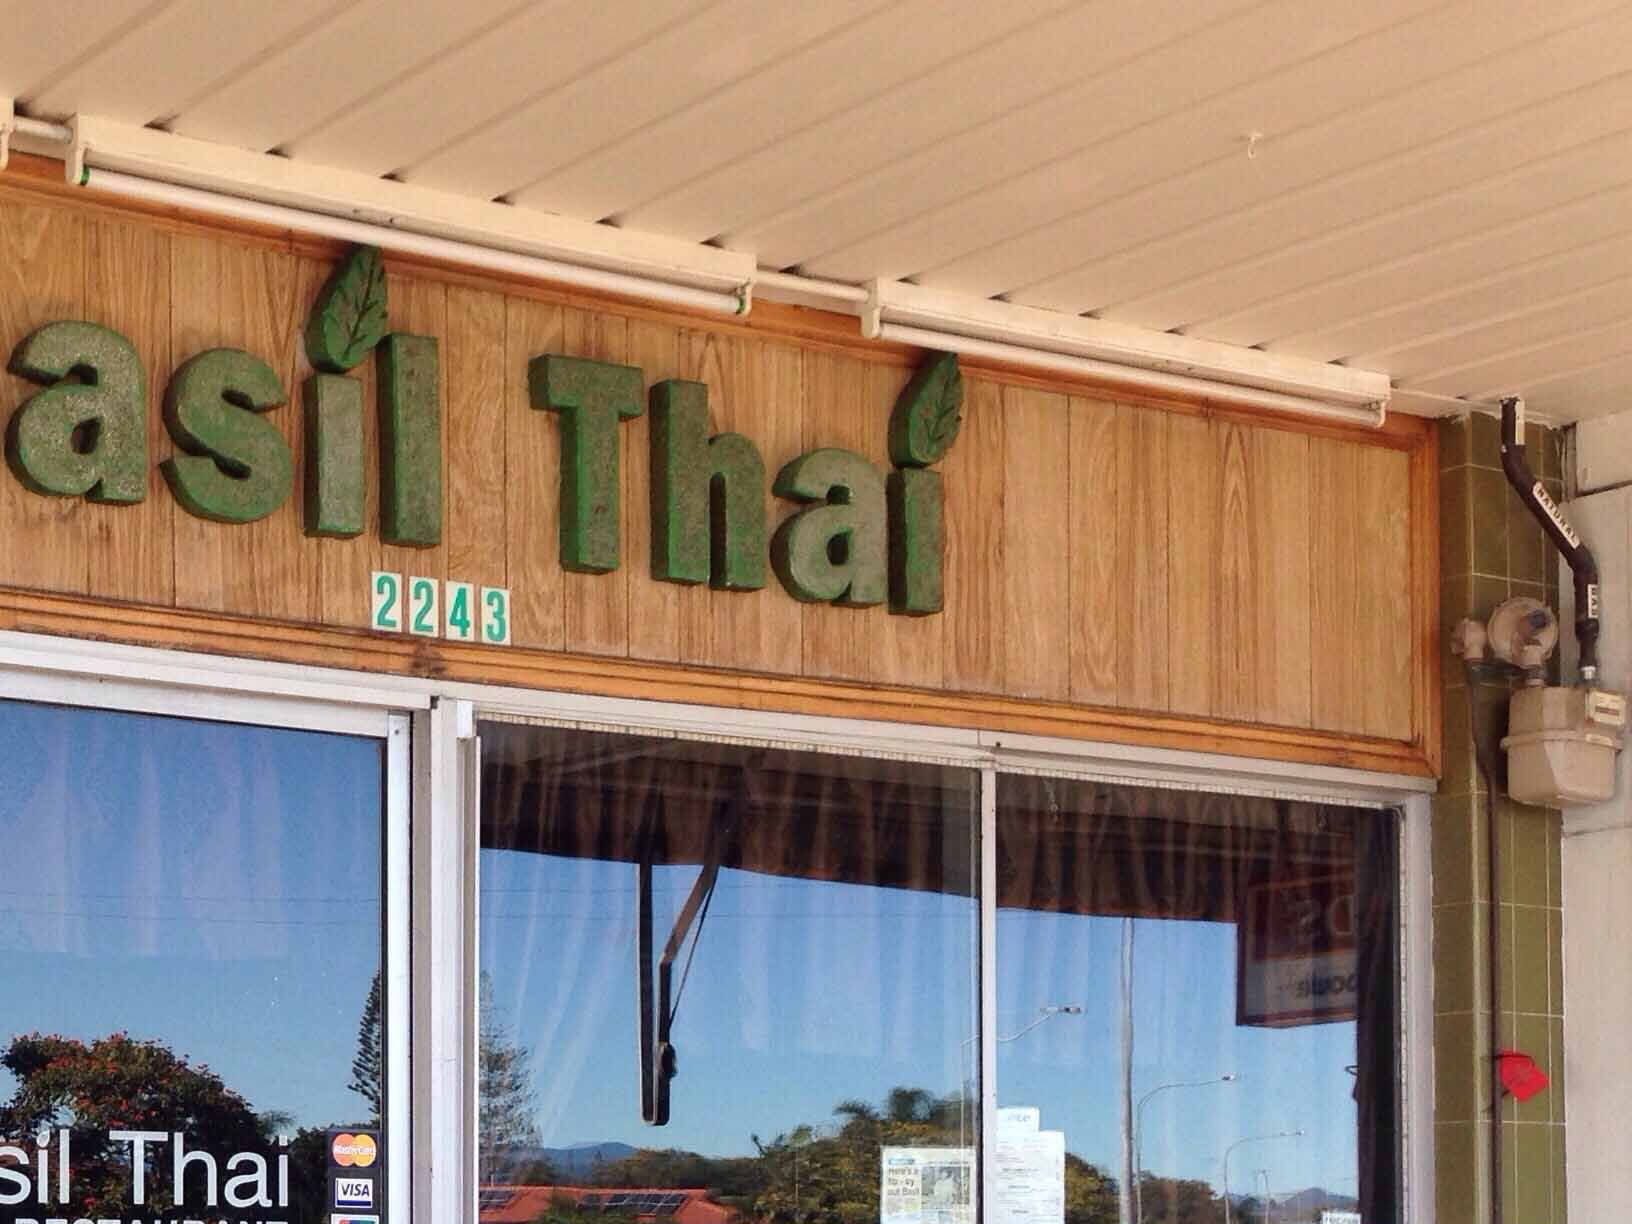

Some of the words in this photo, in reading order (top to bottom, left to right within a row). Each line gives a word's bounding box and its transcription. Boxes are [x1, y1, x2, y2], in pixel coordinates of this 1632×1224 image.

[528, 352, 963, 617] Thai
[376, 574, 507, 642] 2243
[108, 1130, 288, 1209] Thai
[341, 1184, 370, 1197] VISA
